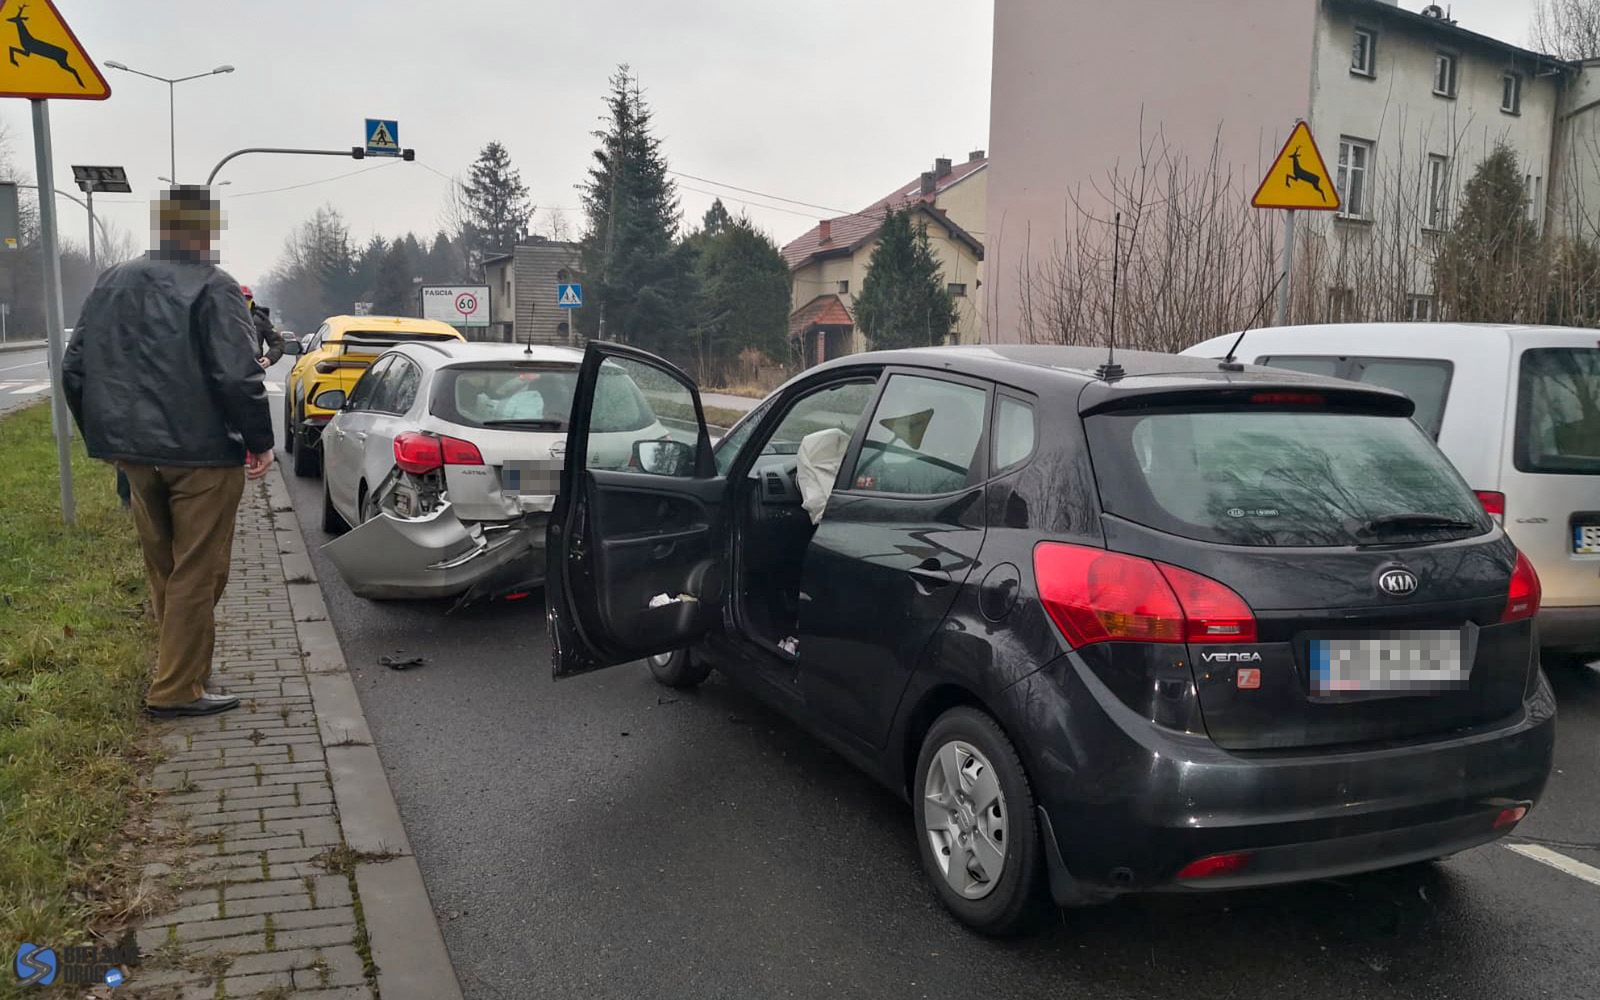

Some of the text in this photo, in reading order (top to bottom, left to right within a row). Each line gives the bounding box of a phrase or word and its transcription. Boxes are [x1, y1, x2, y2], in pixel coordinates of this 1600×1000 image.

[425, 289, 453, 297] FASCIA
[459, 299, 474, 309] 60
[1386, 575, 1415, 592] KIA
[1201, 652, 1262, 662] VENGA
